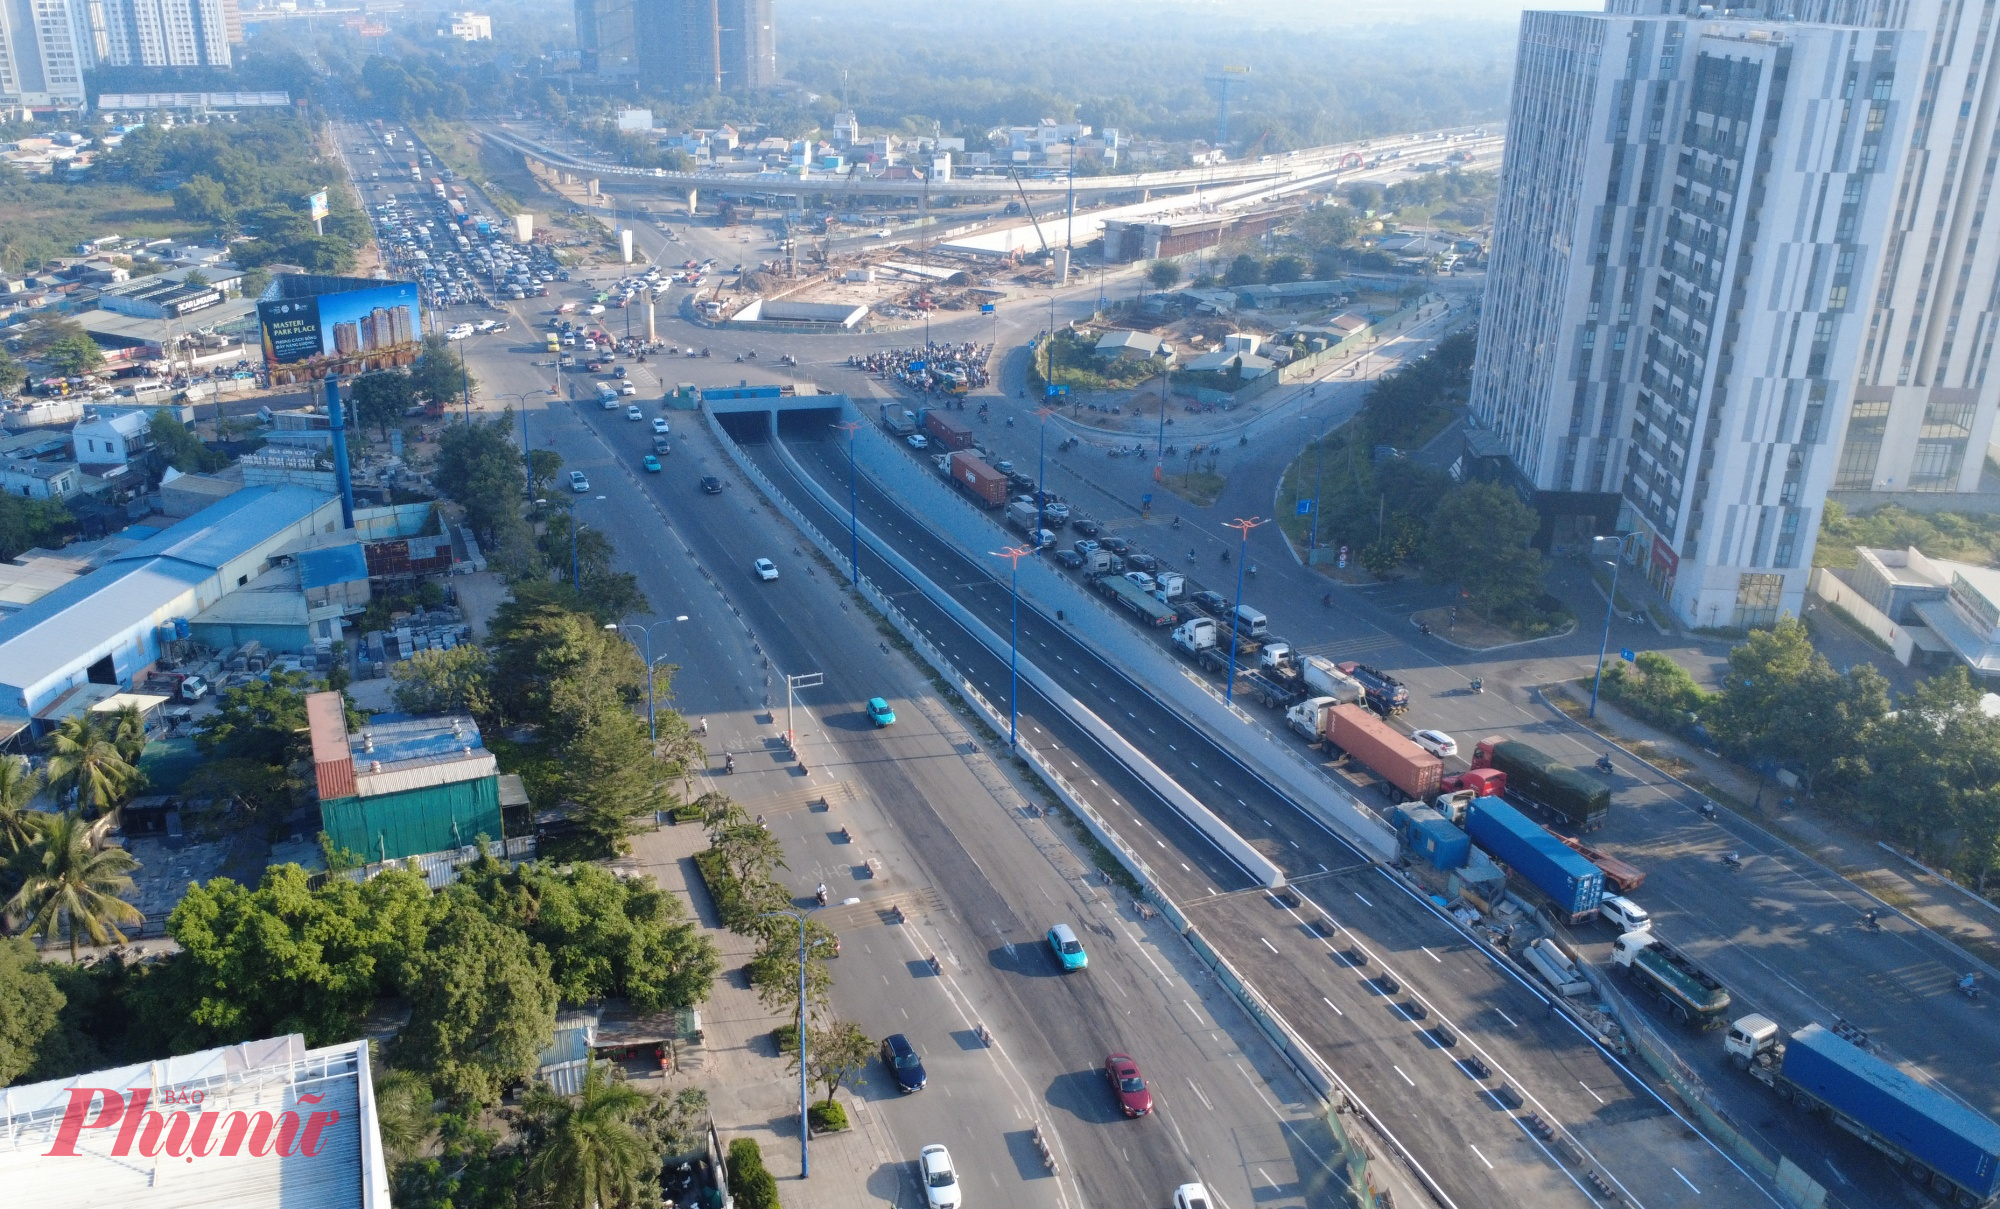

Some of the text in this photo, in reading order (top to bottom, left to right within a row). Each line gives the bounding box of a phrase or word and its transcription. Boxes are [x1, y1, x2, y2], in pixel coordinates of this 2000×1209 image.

[273, 320, 304, 330] MASTERI
[274, 325, 317, 336] PARK PLACE
